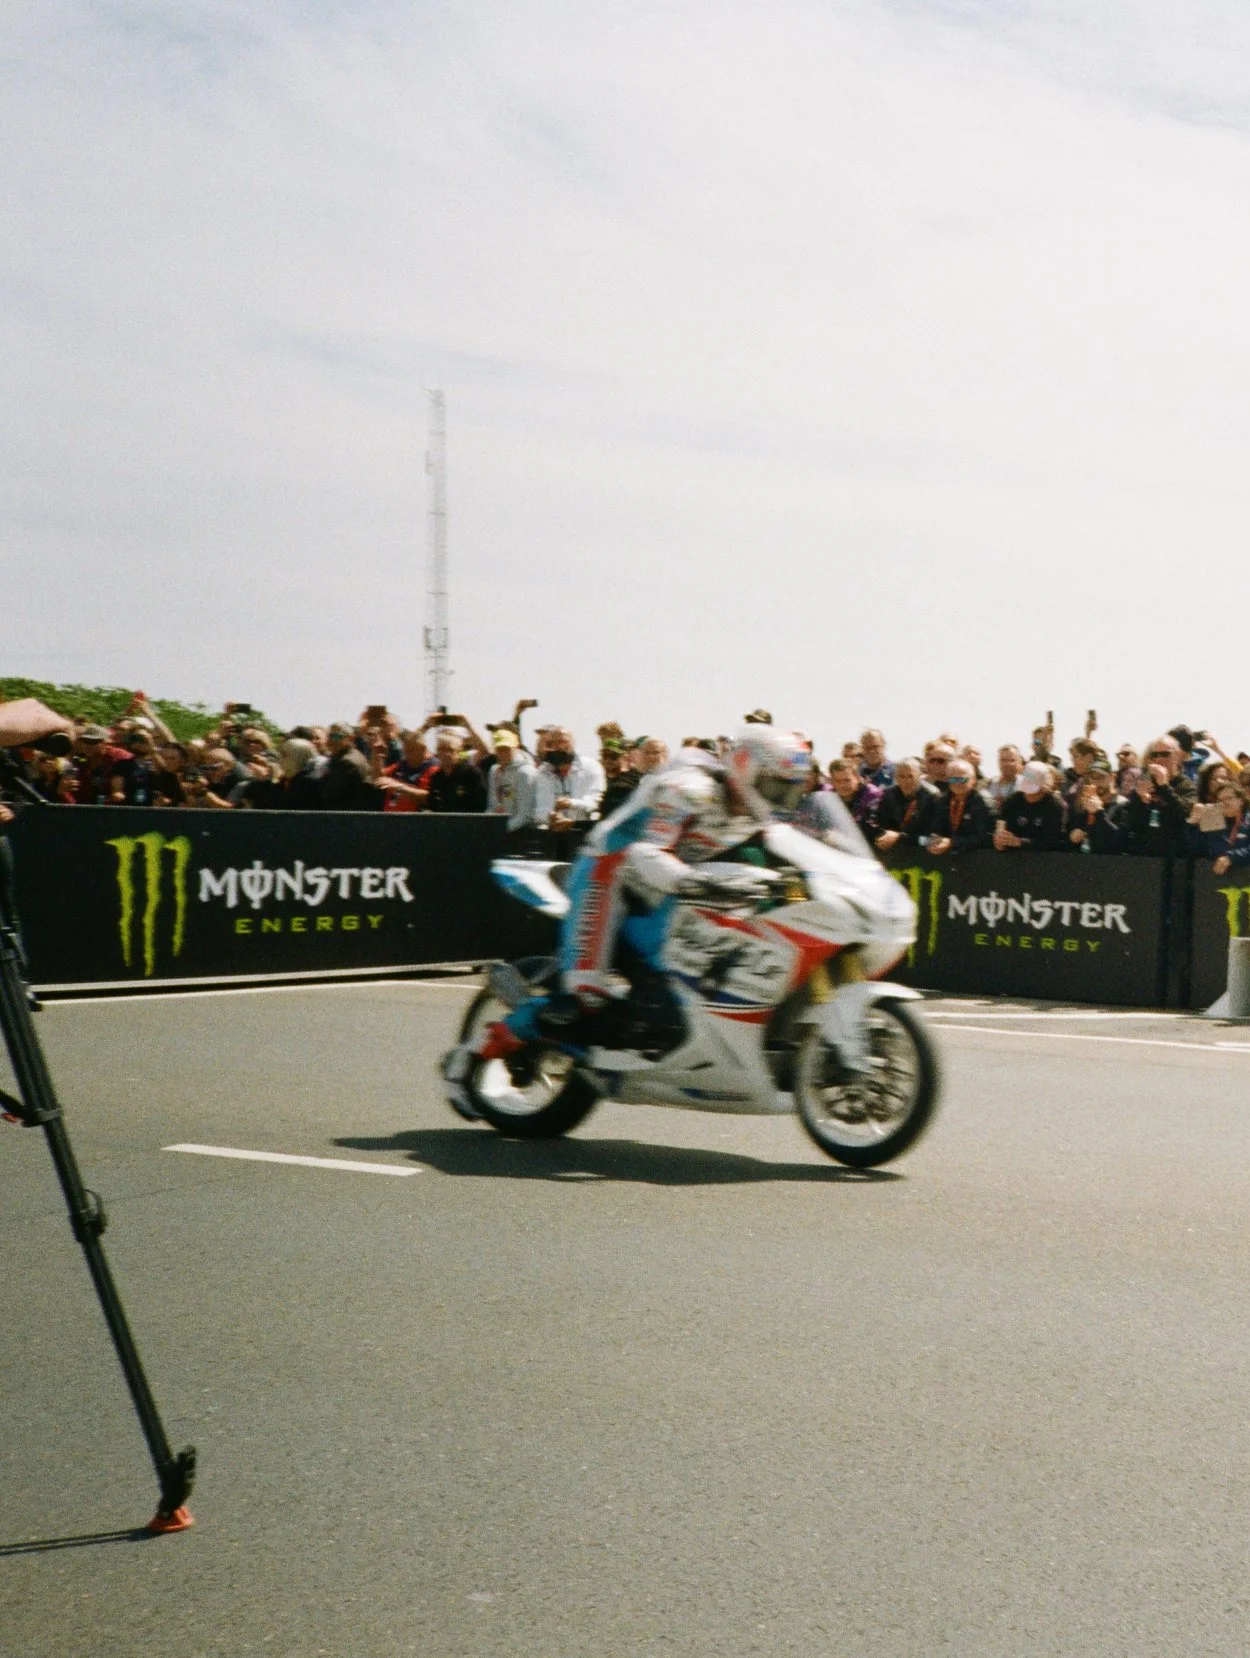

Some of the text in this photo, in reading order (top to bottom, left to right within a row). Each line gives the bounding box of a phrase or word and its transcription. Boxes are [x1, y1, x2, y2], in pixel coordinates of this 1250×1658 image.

[199, 860, 414, 910] MONSTER
[235, 915, 384, 935] ENERGY
[947, 890, 1131, 934] MONSTER
[974, 932, 1102, 953] ENERGY
